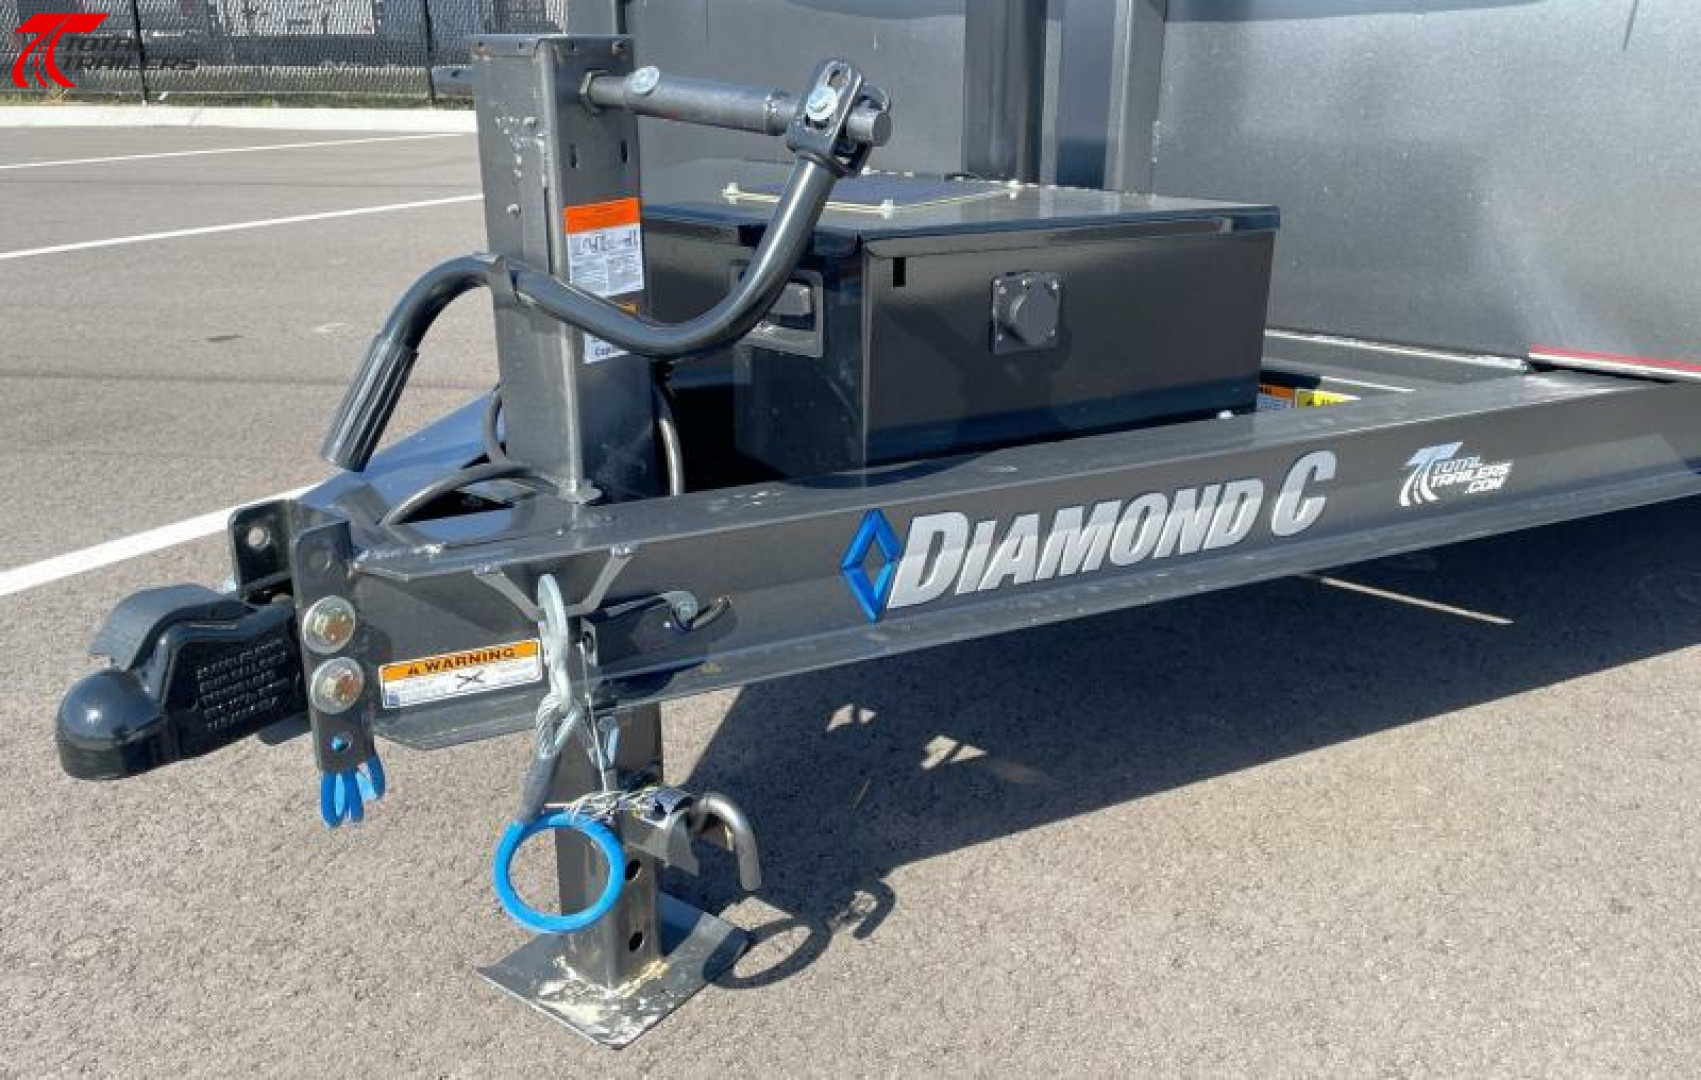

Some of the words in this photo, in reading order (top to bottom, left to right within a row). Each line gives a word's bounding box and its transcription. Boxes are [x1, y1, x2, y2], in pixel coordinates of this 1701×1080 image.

[1430, 462, 1514, 488] TRAILERS
[1432, 455, 1482, 474] TOTAL
[887, 478, 1265, 609] DIAMOND
[1271, 450, 1337, 537] C
[425, 648, 515, 673] WARNING
